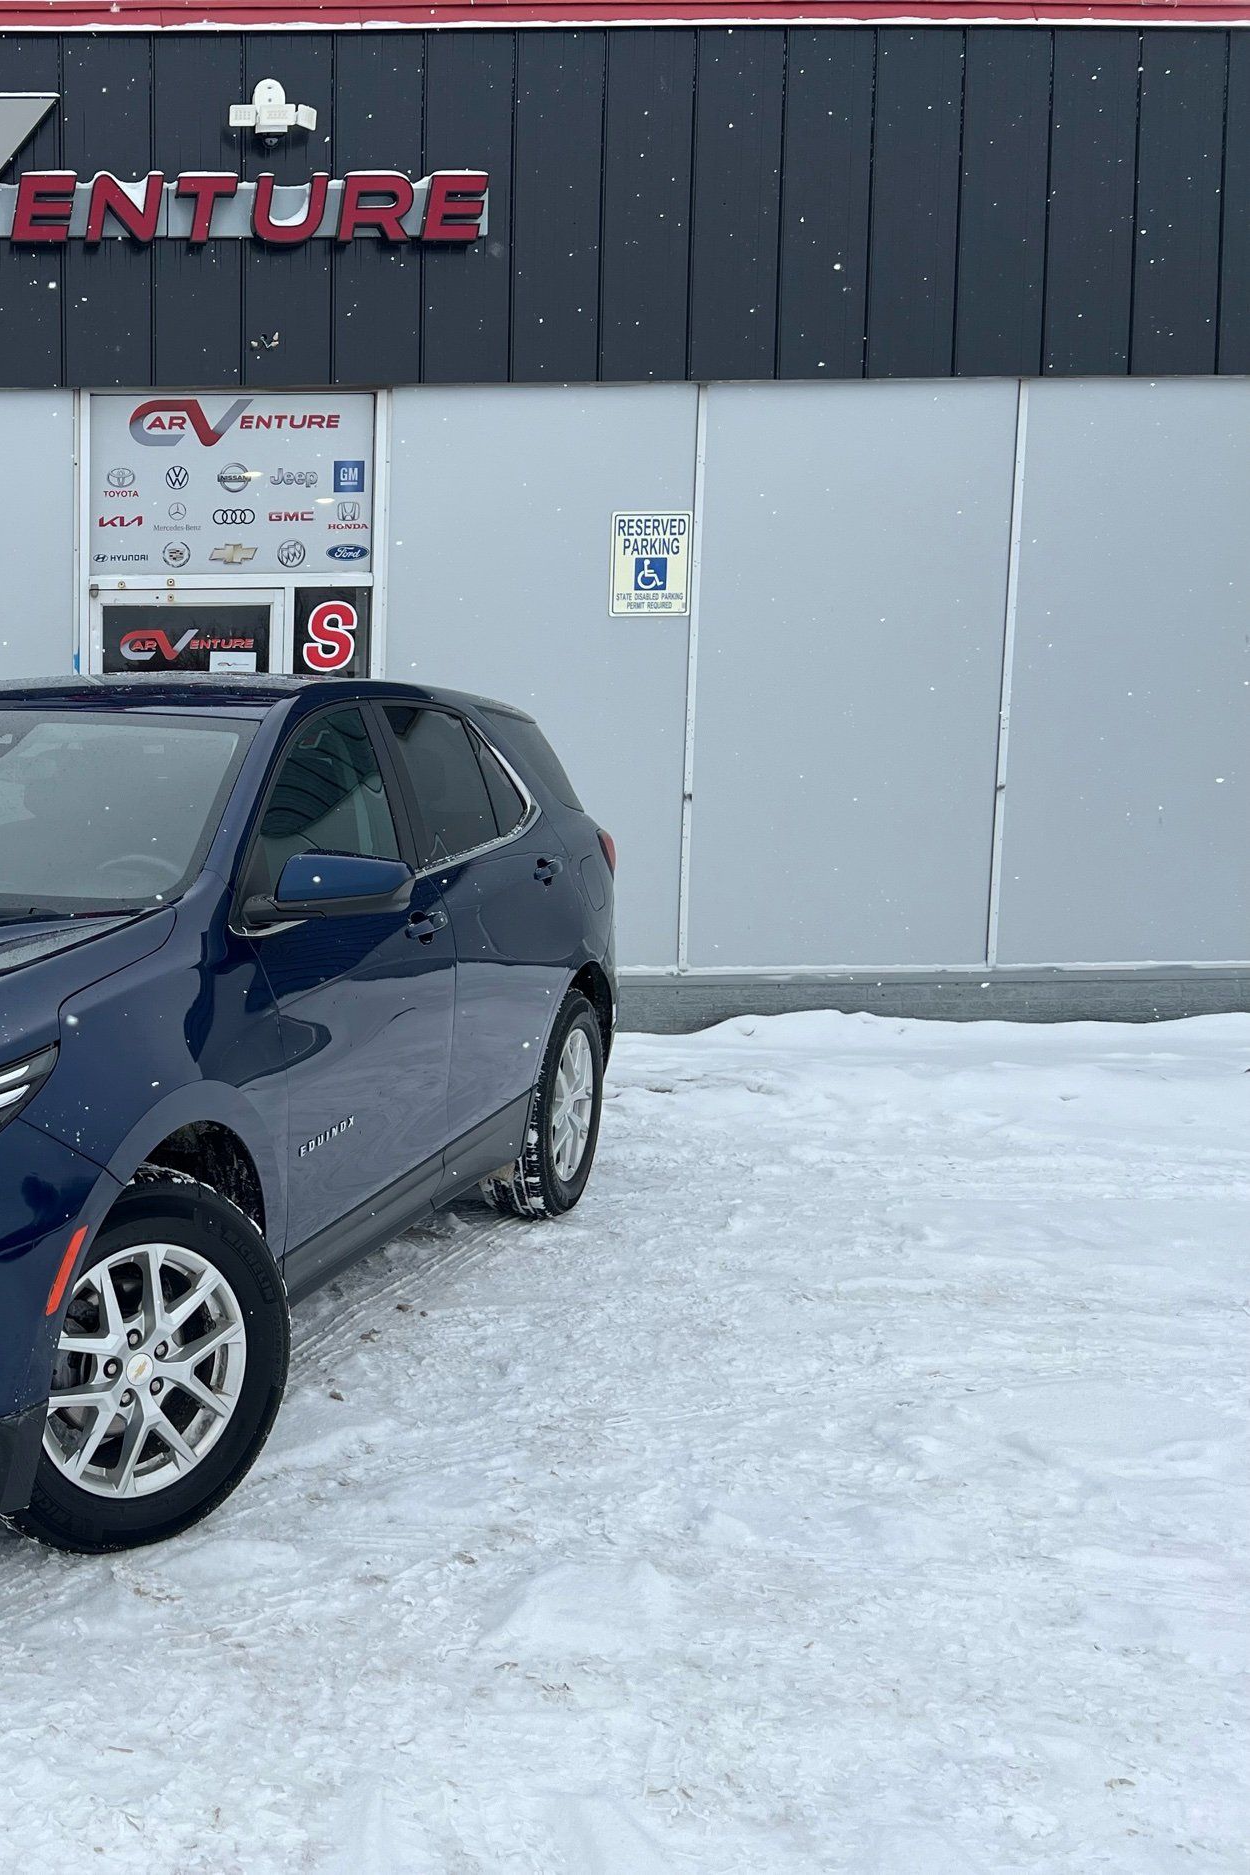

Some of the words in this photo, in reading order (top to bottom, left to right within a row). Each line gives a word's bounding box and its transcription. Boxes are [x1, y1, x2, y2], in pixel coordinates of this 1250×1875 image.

[270, 468, 318, 488] Jeep
[103, 490, 139, 498] TOYOTA
[98, 515, 143, 527] KIA
[268, 511, 314, 521] GMC
[327, 523, 369, 531] HONDA
[618, 518, 686, 536] RESERVED
[334, 546, 361, 558] Ford
[623, 537, 680, 556] PARKING
[110, 554, 149, 562] HYUNDAI
[616, 593, 633, 601] STATE
[634, 593, 660, 601] DISABLED
[661, 592, 684, 600] PARKING
[627, 602, 645, 610] PERMIT
[299, 1115, 355, 1158] EQUINOX
